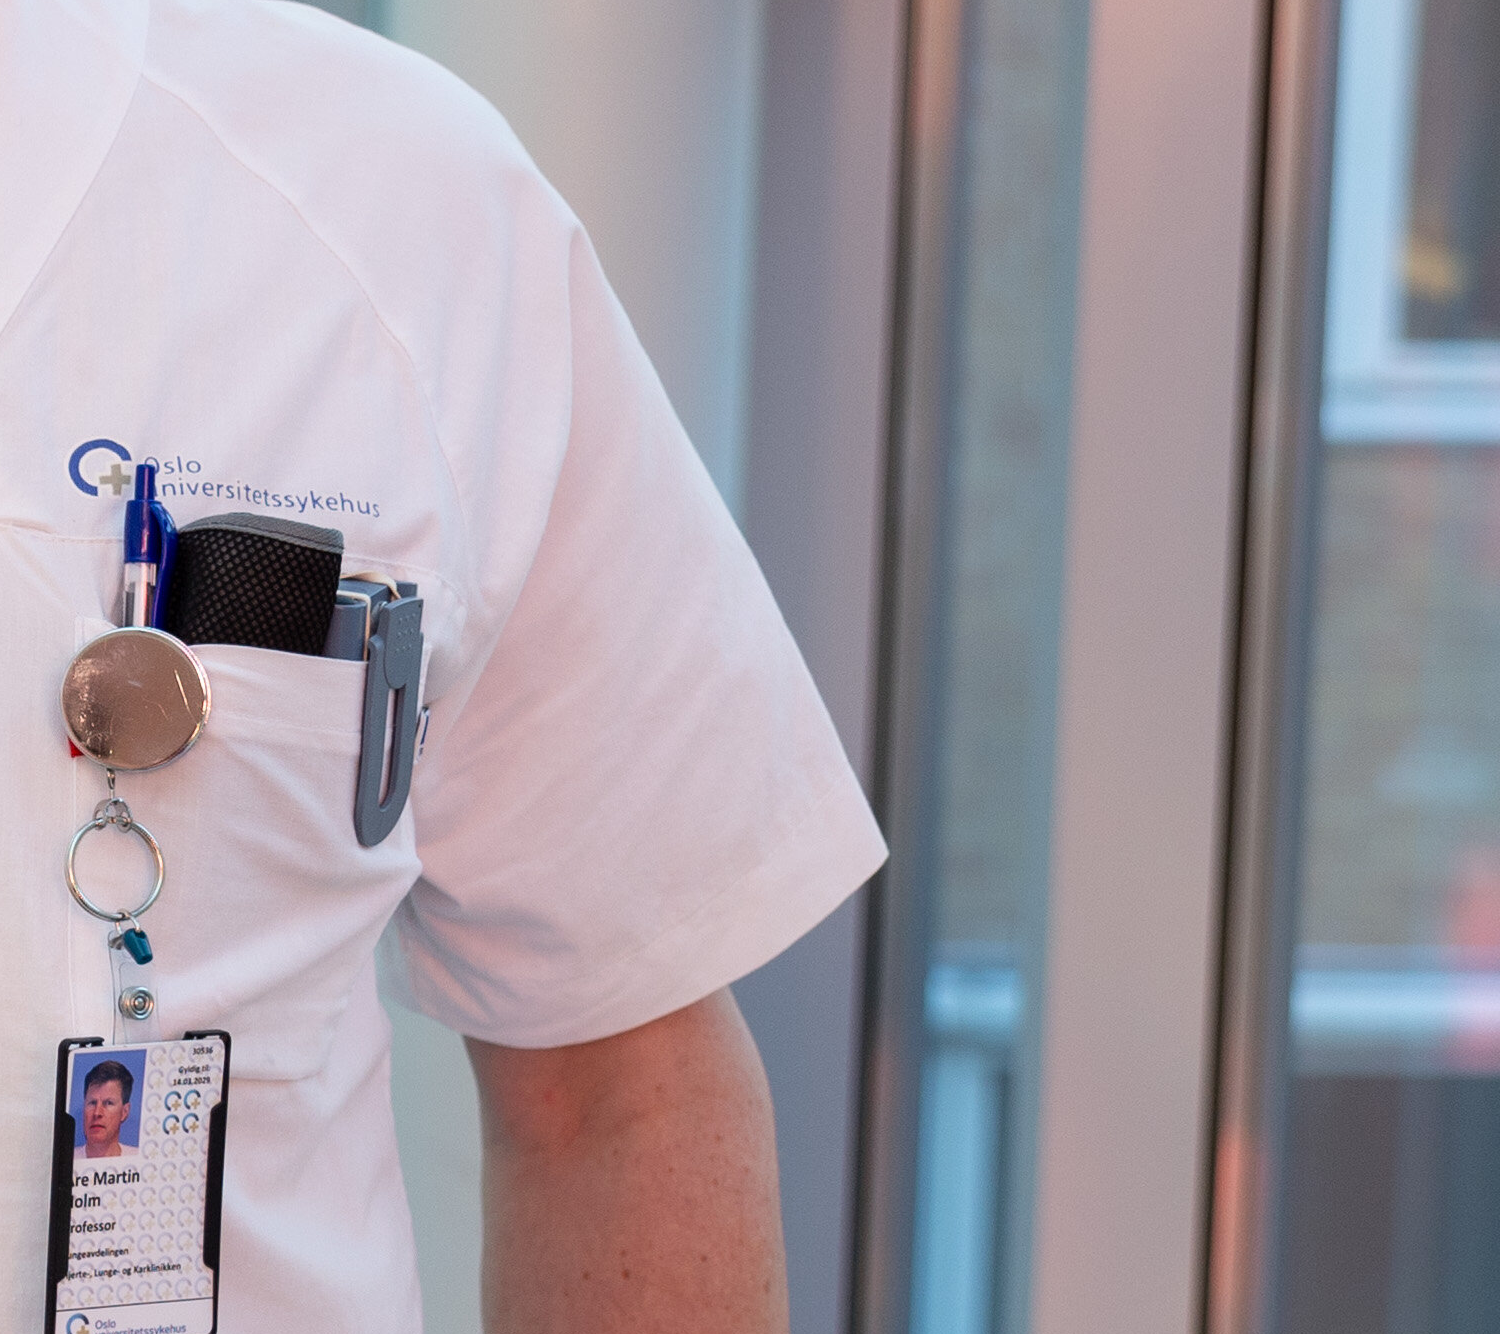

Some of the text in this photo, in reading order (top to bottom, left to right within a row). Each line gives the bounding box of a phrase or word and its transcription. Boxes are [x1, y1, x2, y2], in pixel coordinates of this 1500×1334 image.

[153, 477, 381, 518] niversitetssykehus
[71, 1169, 140, 1187] re Martin
[69, 1220, 116, 1234] rofessor
[67, 1248, 129, 1260] ungeavdelingen
[122, 1267, 132, 1276] og
[94, 1319, 117, 1330] Oslo
